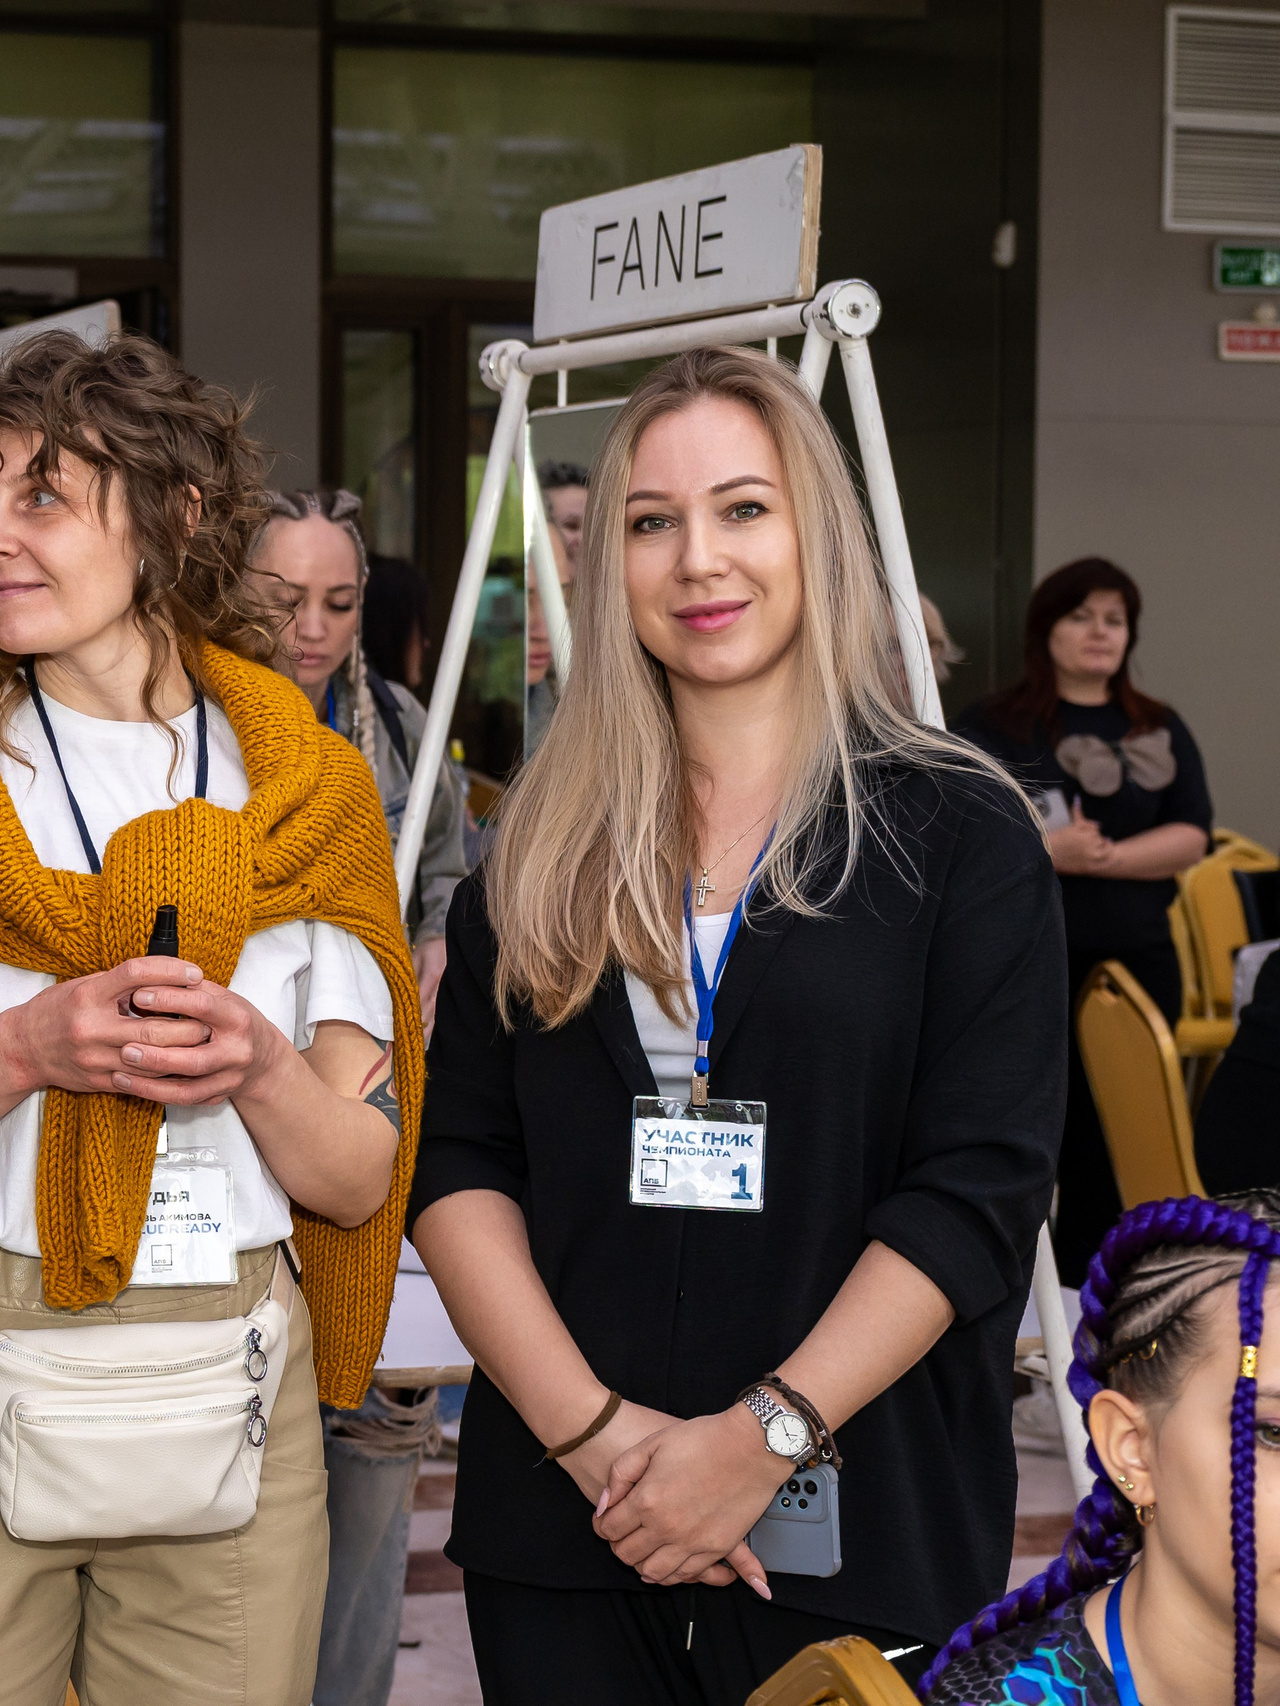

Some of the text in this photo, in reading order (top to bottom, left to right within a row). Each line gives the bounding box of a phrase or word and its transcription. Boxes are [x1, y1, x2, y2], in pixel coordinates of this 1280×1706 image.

[589, 195, 727, 301] FANE
[642, 1128, 754, 1148] УЧАСТНИК
[642, 1144, 731, 1158] ЧЕМПИОНАТА
[730, 1163, 754, 1201] 1
[148, 1190, 190, 1206] ДЬЯ
[159, 1213, 212, 1222] АКИМОВА
[142, 1223, 222, 1235] UDREADY
